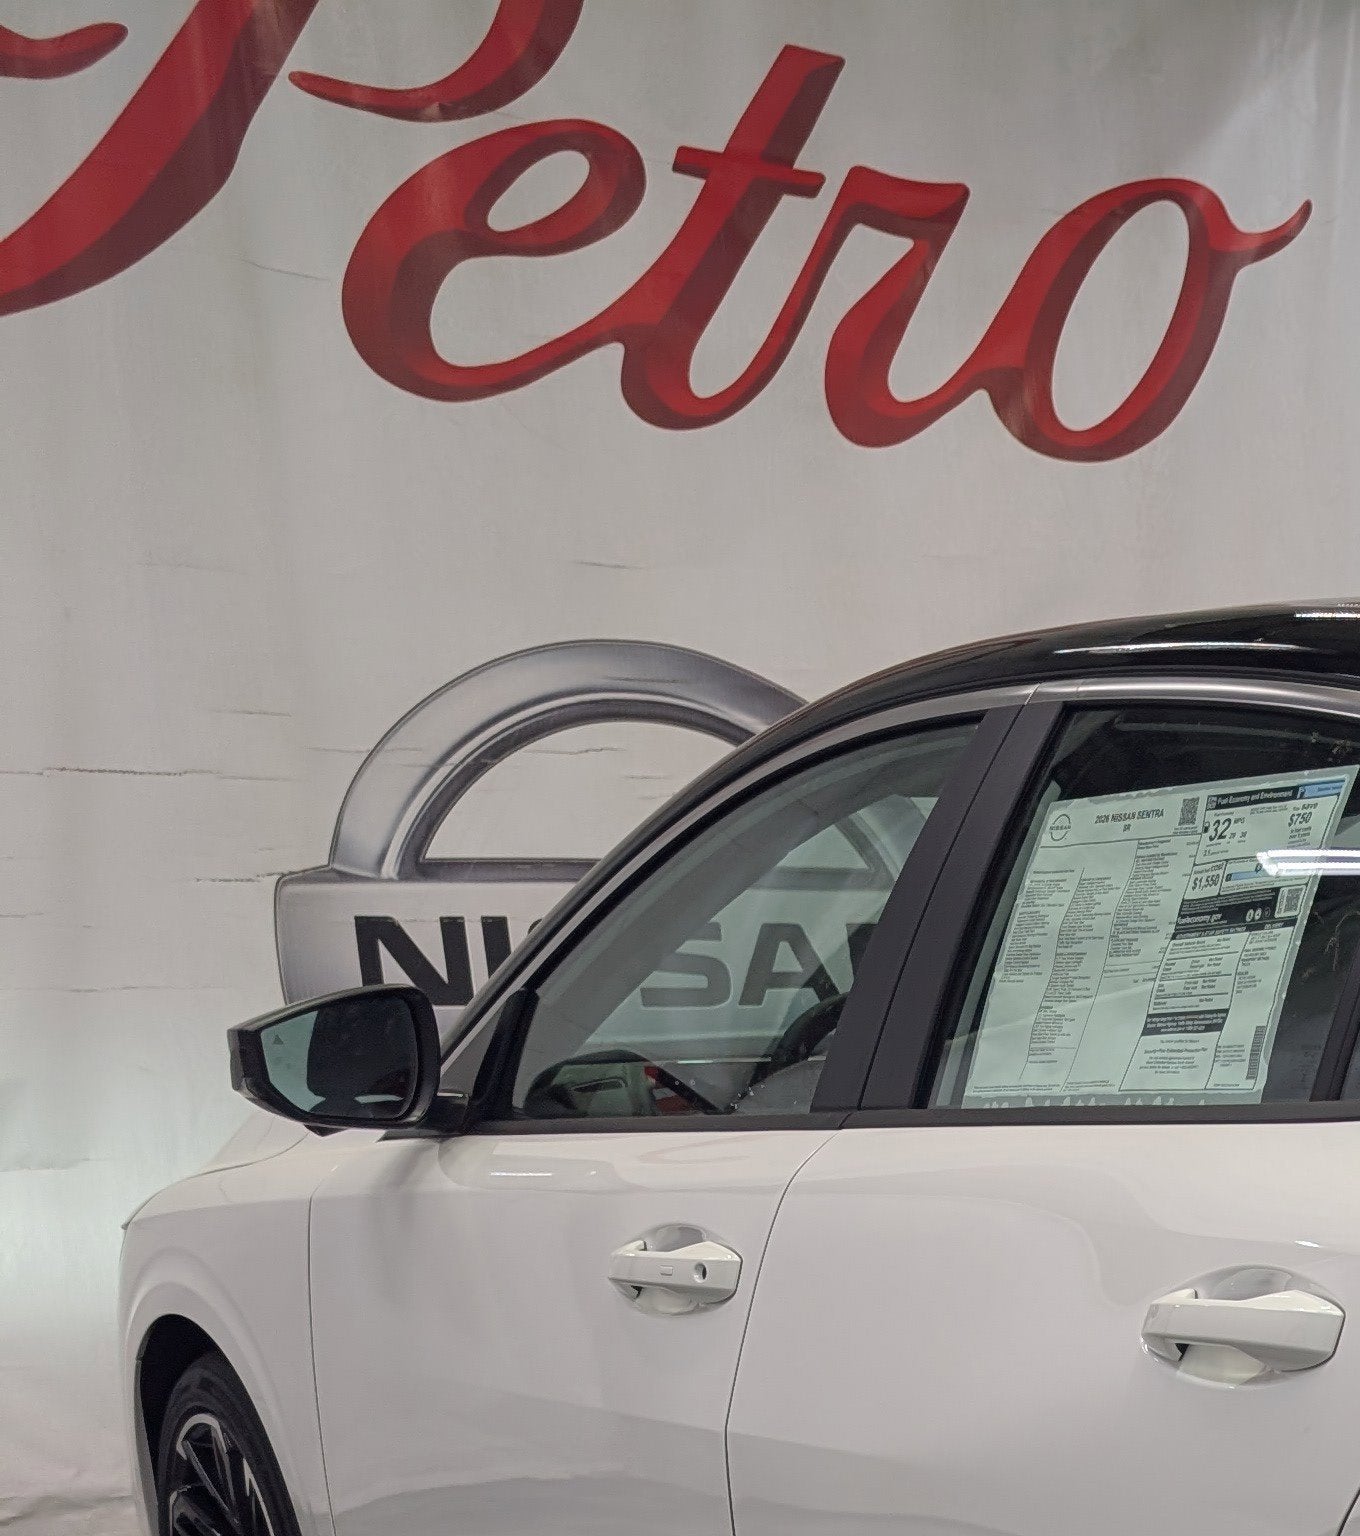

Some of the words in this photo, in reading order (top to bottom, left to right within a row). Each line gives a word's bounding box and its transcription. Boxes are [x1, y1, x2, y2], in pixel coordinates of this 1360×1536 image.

[1095, 813, 1110, 824] 2026
[1110, 811, 1137, 823] NISSAN
[1136, 808, 1164, 820] SENTRA
[1288, 812, 1313, 828] $750
[1208, 818, 1232, 842] 32
[1192, 873, 1220, 891] $1,550
